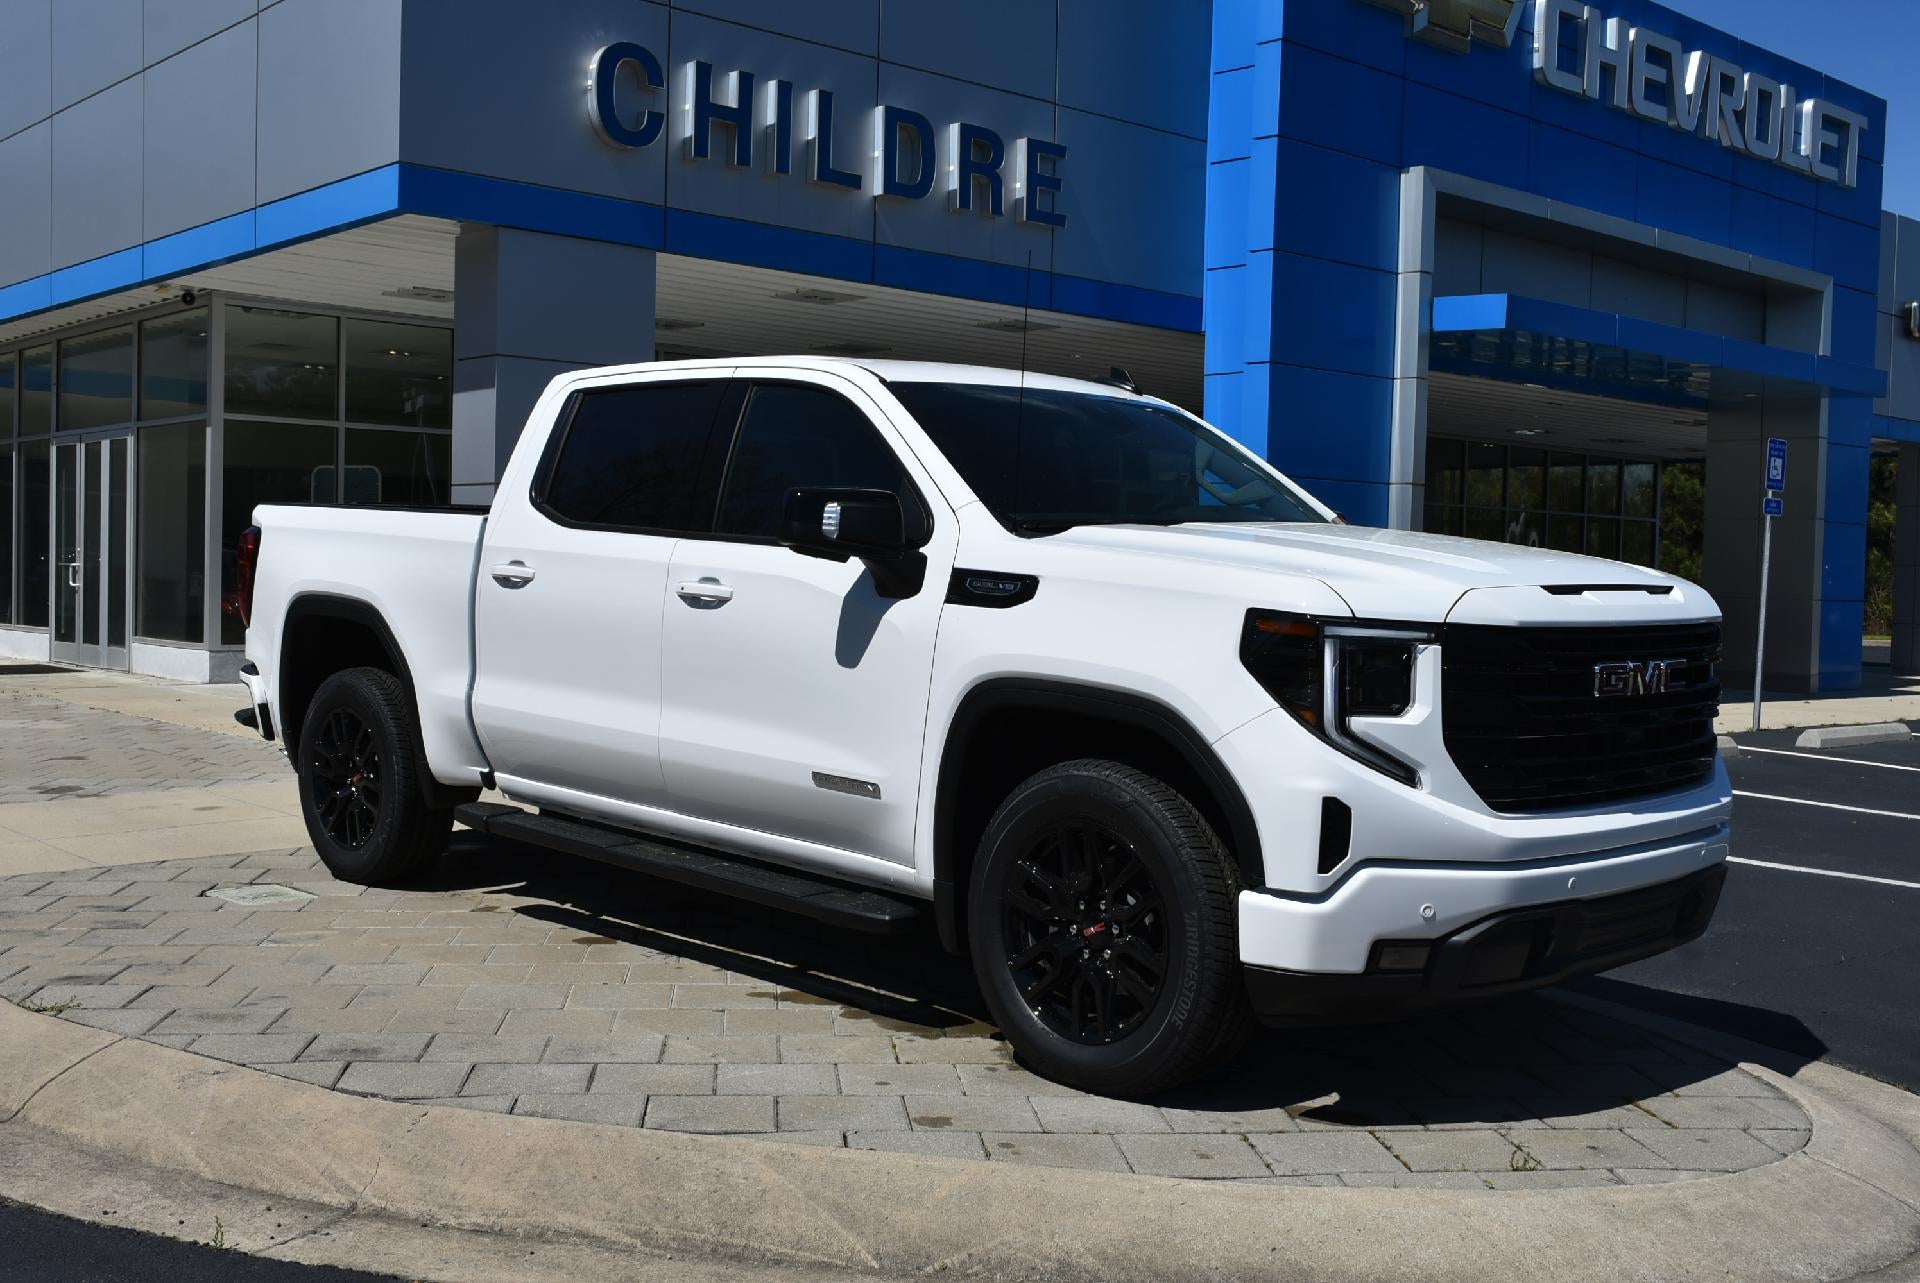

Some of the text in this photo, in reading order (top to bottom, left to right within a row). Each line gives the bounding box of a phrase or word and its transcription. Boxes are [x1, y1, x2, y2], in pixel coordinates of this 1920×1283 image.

[587, 41, 1067, 228] CHILDRE
[1533, 0, 1868, 187] CHEVROLET
[1594, 659, 1686, 697] GMC
[1171, 911, 1199, 1030] BRIDGESTONE
